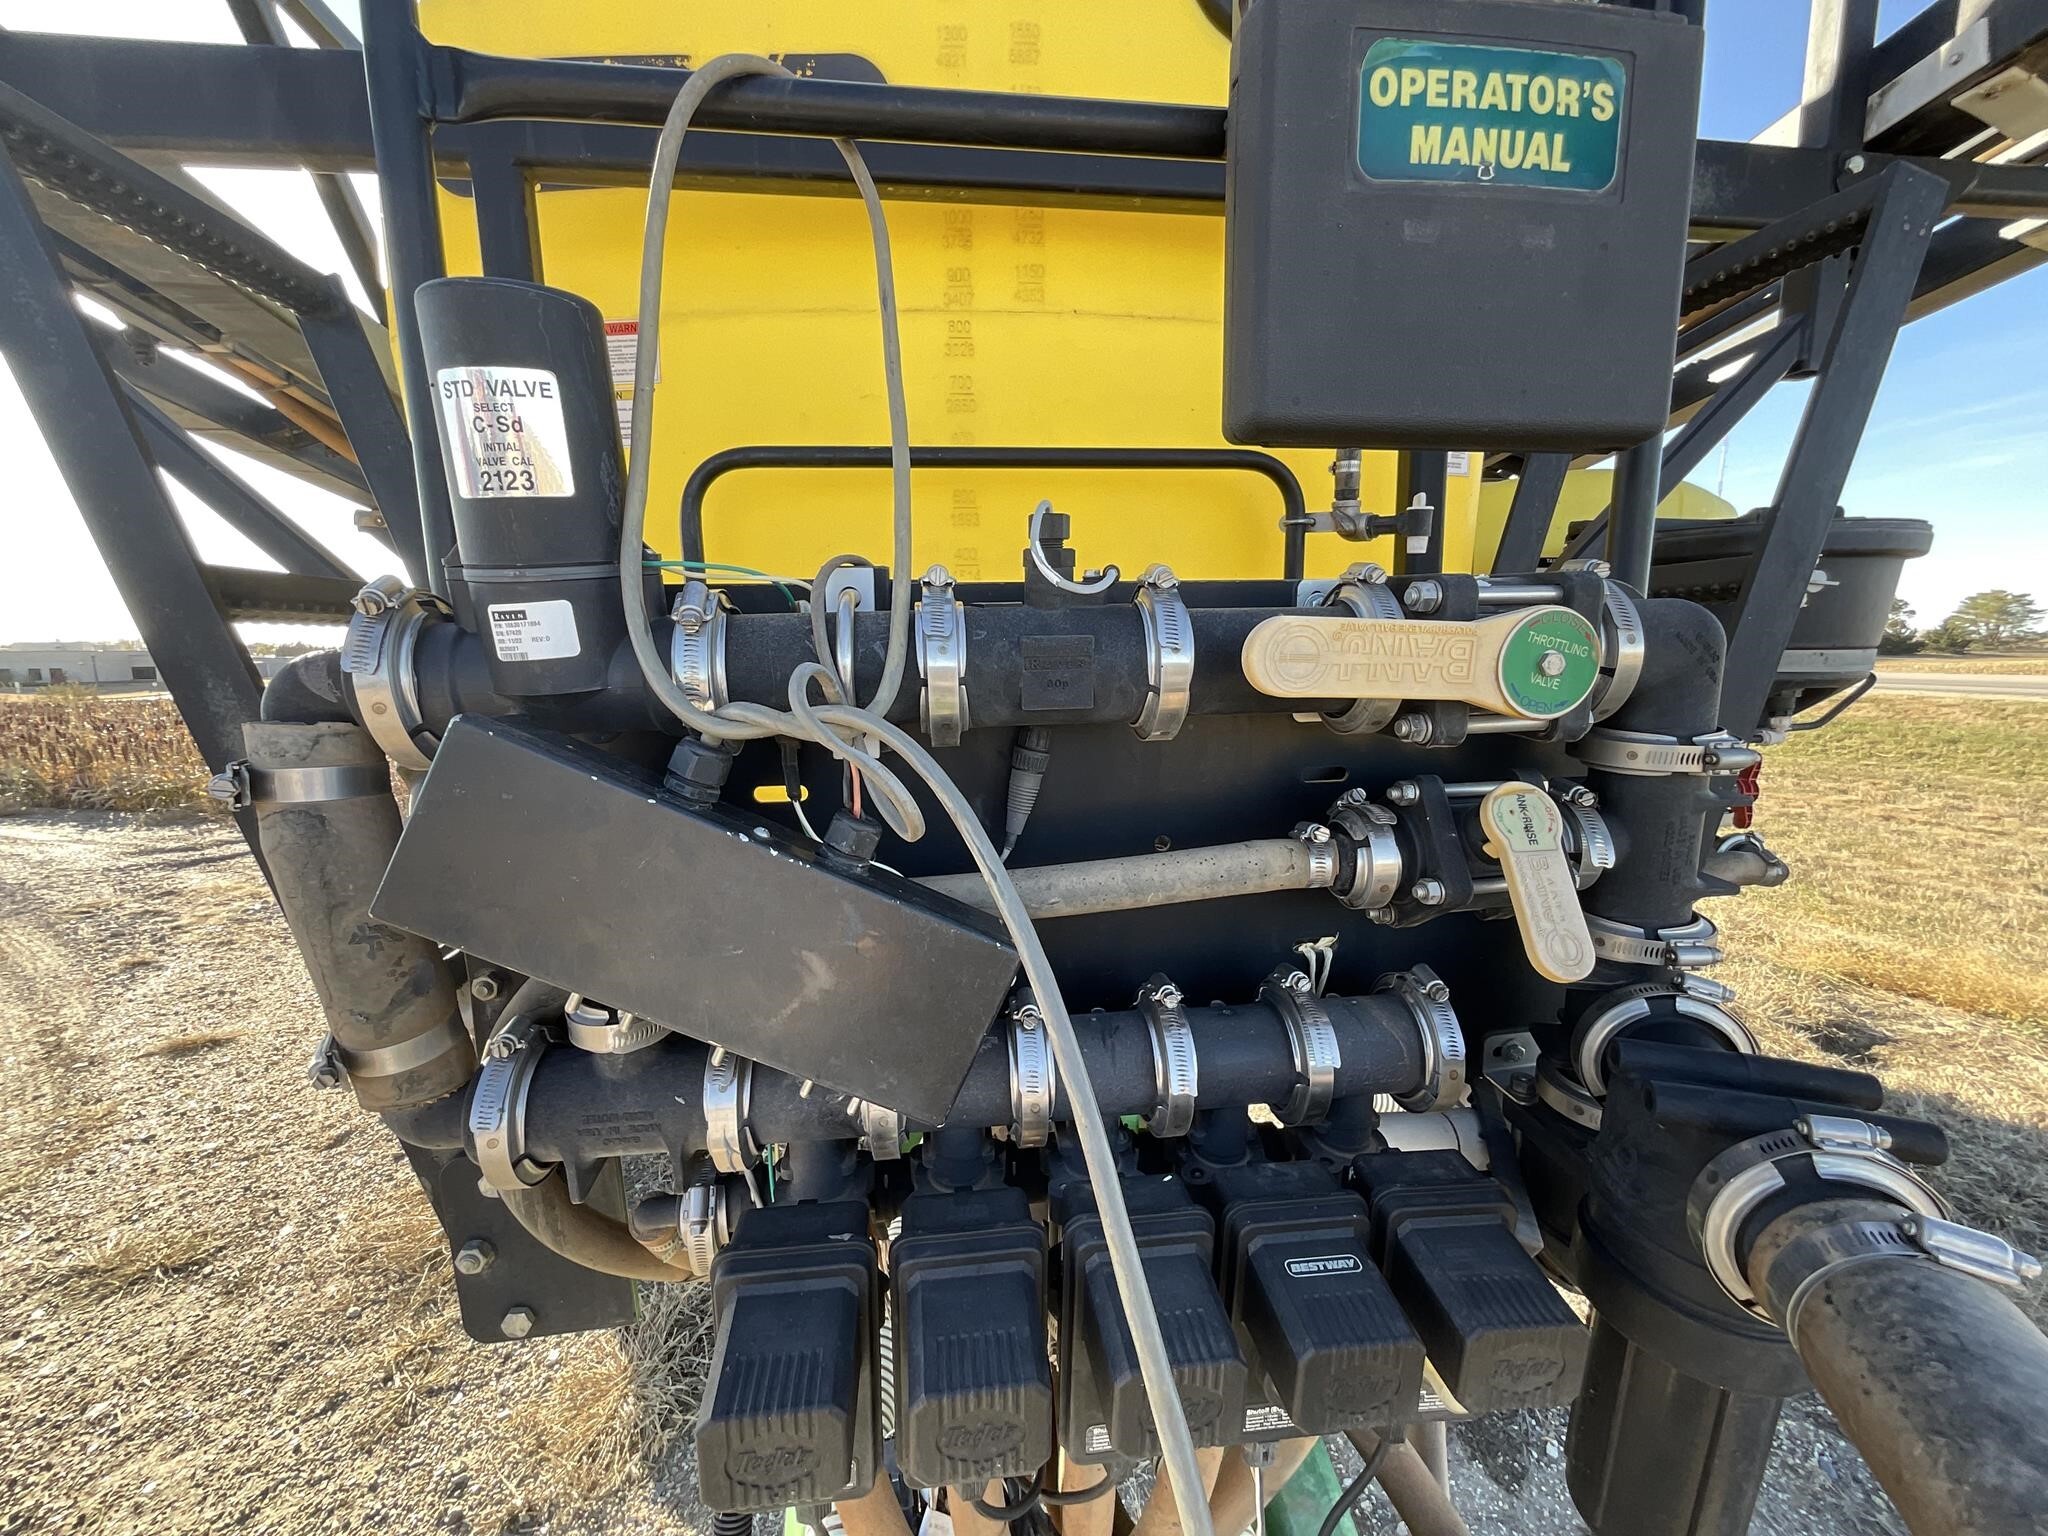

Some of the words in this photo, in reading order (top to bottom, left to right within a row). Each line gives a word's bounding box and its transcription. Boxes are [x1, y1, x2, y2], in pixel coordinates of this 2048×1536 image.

[1370, 67, 1614, 121] OPERATOR'S
[1410, 125, 1571, 172] MANUAL
[609, 322, 637, 334] WARN
[443, 380, 474, 400] STD
[485, 379, 553, 399] VALVE
[473, 402, 515, 412] SELECT
[483, 442, 521, 451] INITIAL
[476, 457, 507, 466] VALVE
[512, 457, 534, 466] CAL
[481, 470, 535, 492] 2123
[1528, 631, 1589, 657] THROTTLING
[1530, 672, 1561, 690] VALVE
[1521, 696, 1553, 712] OPEN
[1515, 793, 1539, 847] ANK-RINSE
[1290, 1258, 1355, 1273] BESTWAY
